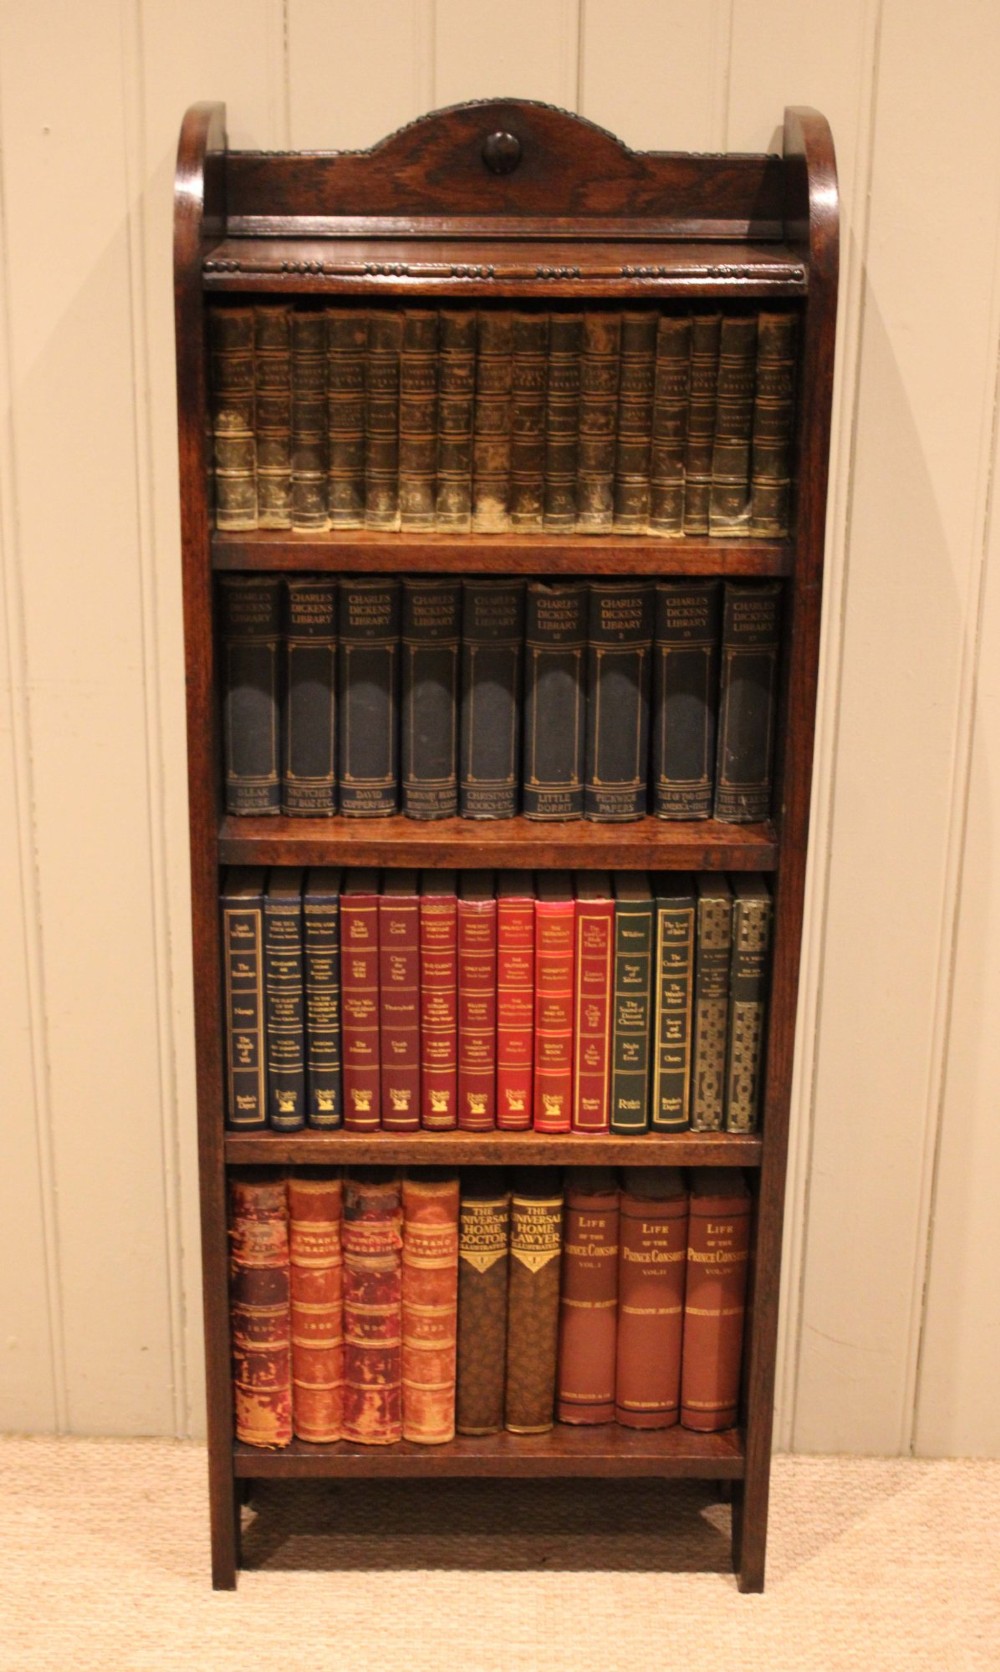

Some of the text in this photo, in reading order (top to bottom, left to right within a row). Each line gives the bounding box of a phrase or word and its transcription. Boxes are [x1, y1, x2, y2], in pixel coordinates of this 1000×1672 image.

[290, 593, 334, 602] CHARLES
[348, 594, 391, 604] CHARLES
[666, 597, 709, 607] CHARLES
[537, 599, 578, 609] CHARLES
[600, 598, 643, 608] CHARLES
[291, 604, 334, 613] DICKENS
[349, 605, 391, 615] DICKENS
[413, 606, 455, 616] DICKENS
[666, 607, 709, 617] DICKENS
[291, 614, 333, 624] LIBRARY
[537, 609, 578, 620] DICKENS
[601, 609, 643, 619] DICKENS
[349, 616, 391, 625] LIBRARY
[413, 616, 453, 626] LIBRARY
[537, 620, 577, 630] LIBRARY
[601, 620, 642, 630] LIBRARY
[667, 618, 707, 628] LIBRARY
[355, 790, 383, 799] DAVID
[538, 794, 571, 803] LITTLE
[537, 803, 572, 812] DORRIT
[599, 803, 635, 813] PAPERS
[472, 1207, 494, 1216] THE
[527, 1207, 547, 1216] THE
[578, 1216, 606, 1228] LIFE
[464, 1224, 502, 1234] HOME
[517, 1223, 555, 1234] HOME
[642, 1223, 669, 1234] LIFE
[706, 1223, 734, 1234] LIFE
[409, 1238, 451, 1247] STRAND
[460, 1233, 507, 1244] DOCTOR
[511, 1232, 561, 1244] LAWYER
[623, 1246, 651, 1263] PRINCE
[687, 1247, 716, 1263] PRINCE
